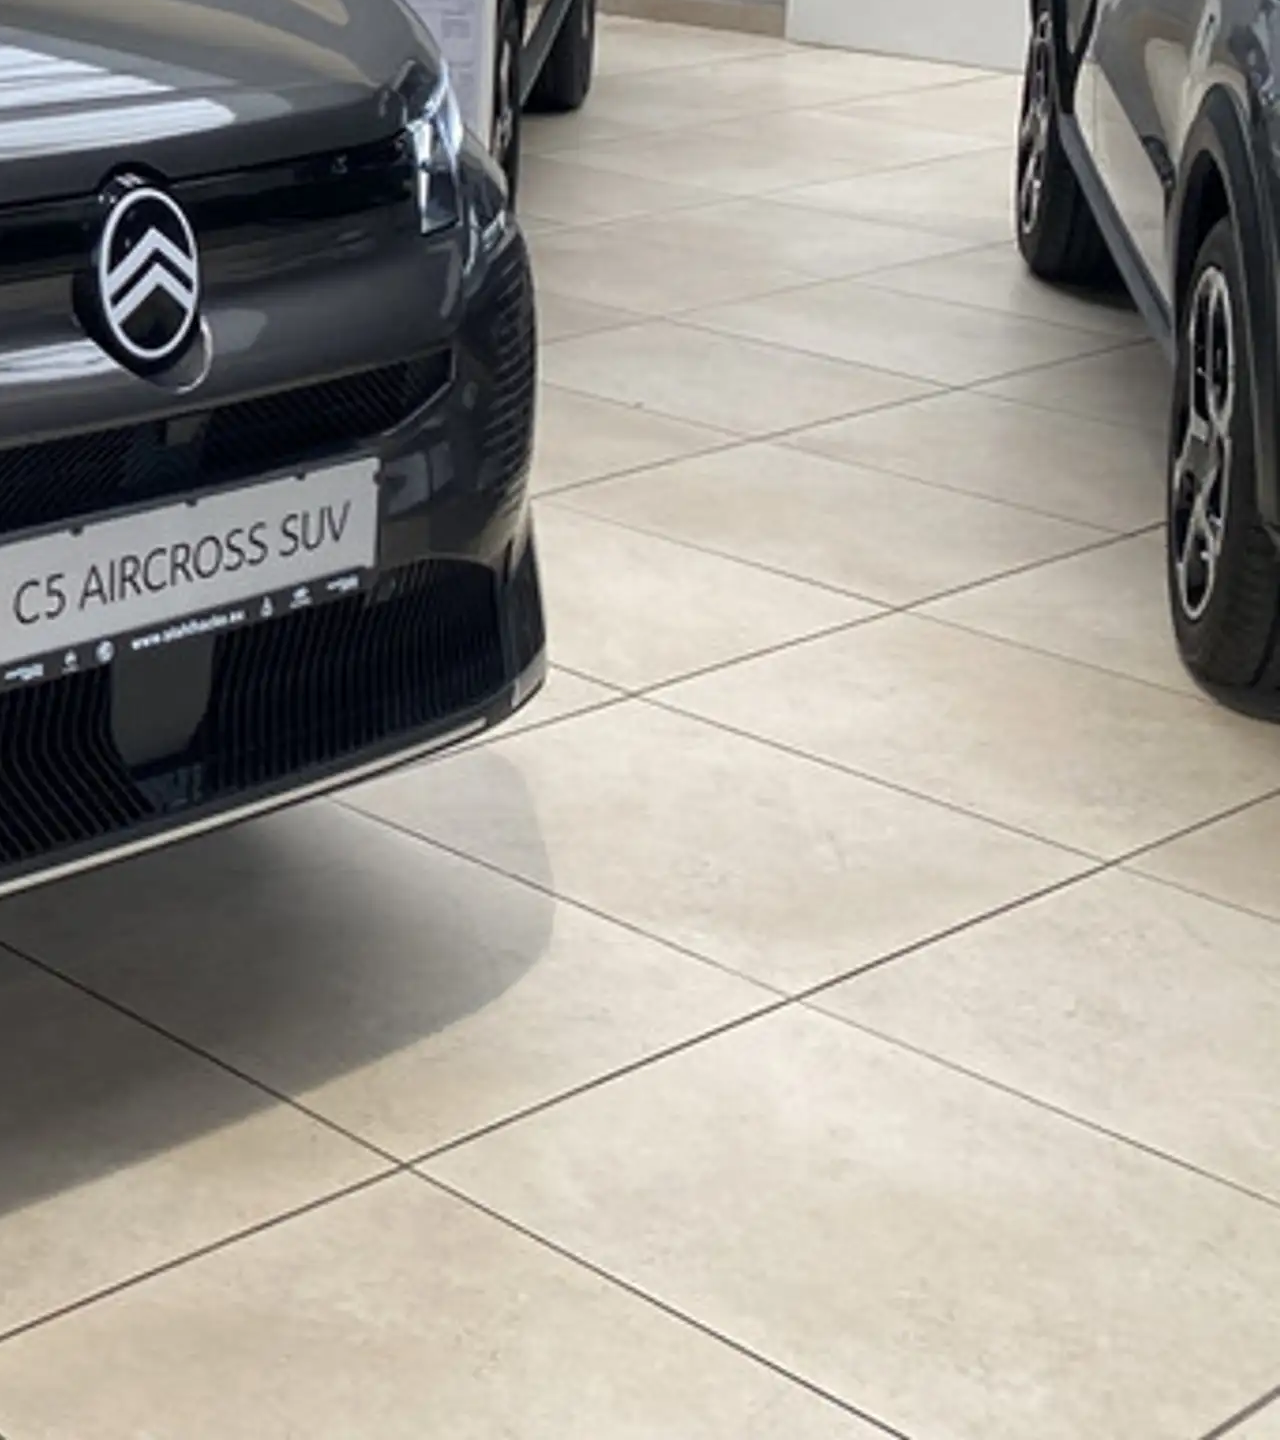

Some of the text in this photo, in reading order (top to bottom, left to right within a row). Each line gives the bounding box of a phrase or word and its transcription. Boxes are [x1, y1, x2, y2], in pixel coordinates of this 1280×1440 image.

[13, 500, 351, 625] C5 AIRCROSS SUV
